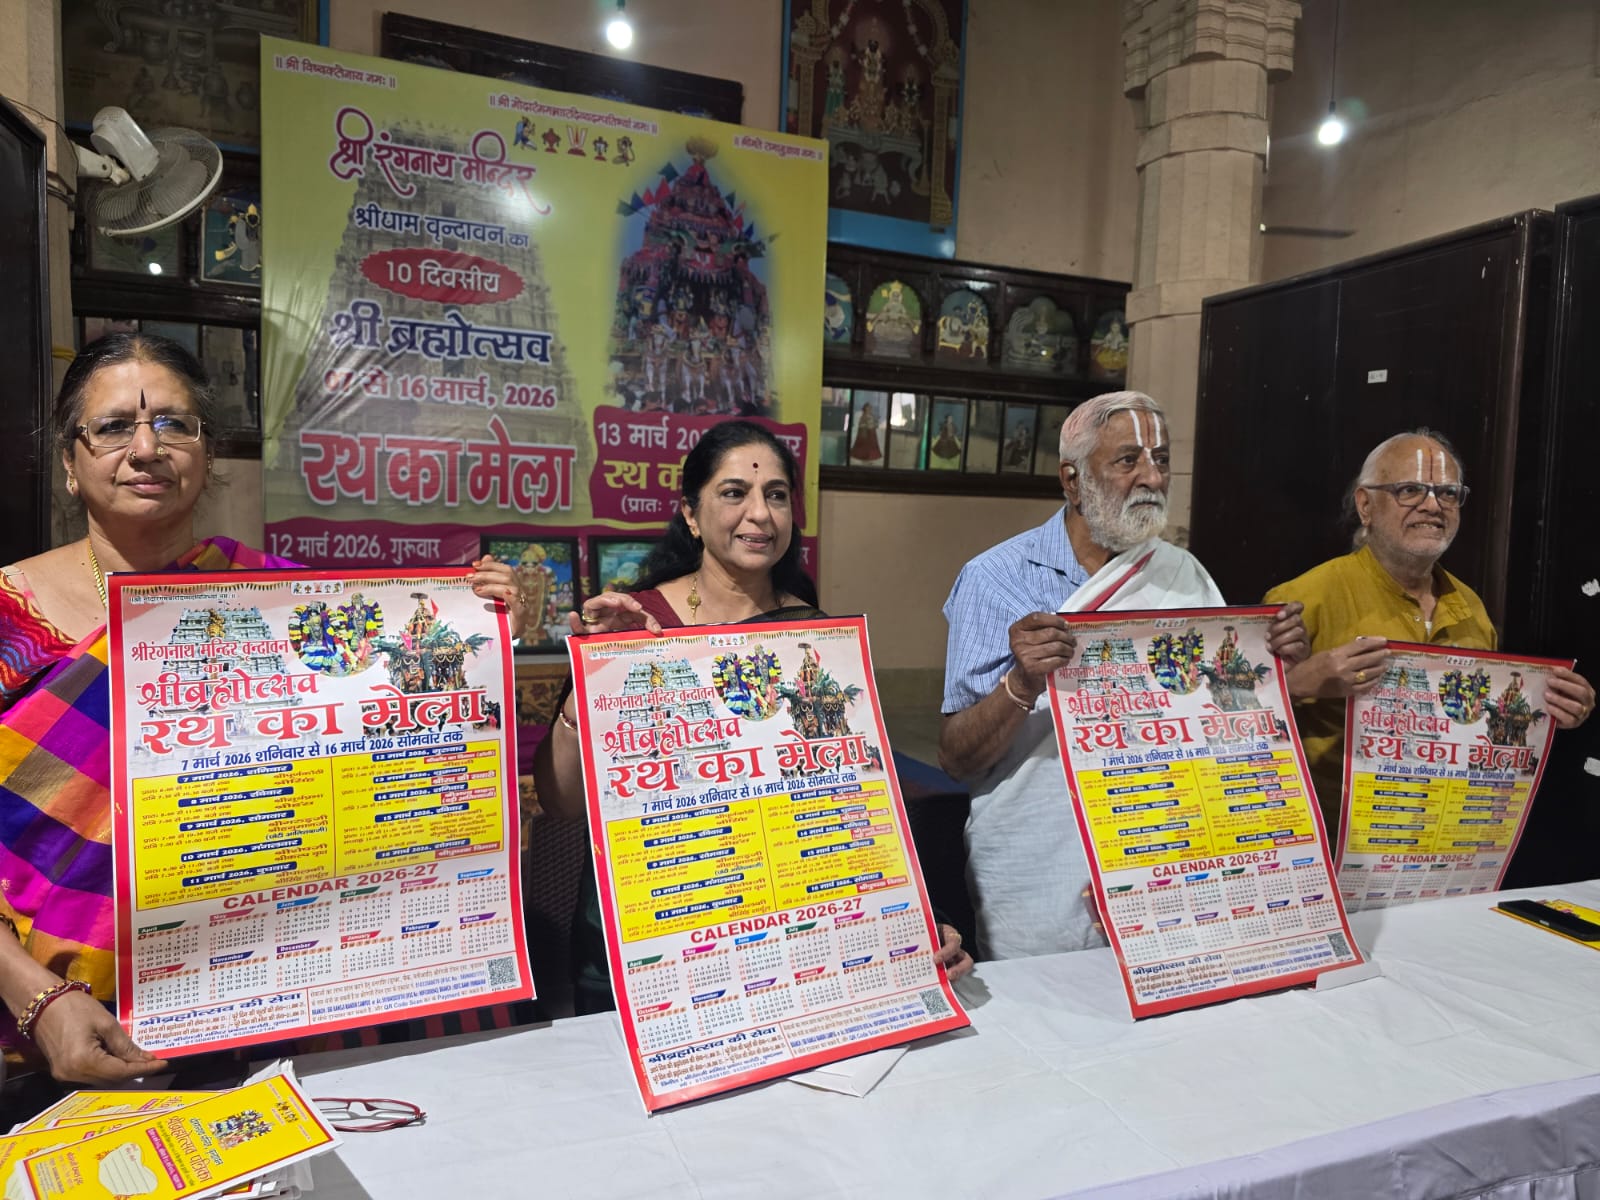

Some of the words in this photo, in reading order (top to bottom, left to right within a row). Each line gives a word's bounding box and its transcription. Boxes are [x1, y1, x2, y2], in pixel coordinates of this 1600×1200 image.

[286, 56, 299, 70] श्री
[330, 107, 374, 180] श्री
[373, 131, 456, 196] रंगनाथ
[460, 131, 551, 215] मन्दिर
[355, 203, 420, 233] श्रीधाम
[425, 216, 506, 243] वृन्दावन
[508, 232, 528, 248] का
[386, 261, 412, 284] 10
[420, 259, 501, 292] दिवसीय
[328, 300, 382, 348] श्री
[386, 310, 552, 362] ब्रह्मोत्सव
[362, 366, 389, 395] से
[400, 376, 426, 398] 16
[432, 375, 497, 407] मार्च,
[504, 385, 556, 408] 2026
[598, 422, 621, 446] 13
[628, 416, 670, 449] मार्च
[676, 427, 708, 450] 20
[301, 432, 382, 502] रथ
[385, 438, 463, 504] का
[467, 416, 576, 511] मेला
[603, 460, 650, 490] रथ
[658, 455, 685, 492] क
[621, 494, 662, 515] (प्रातः
[270, 533, 291, 558] 12
[298, 532, 330, 558] मार्च
[332, 536, 386, 561] 2026,
[132, 640, 195, 662] श्रीरंगनाथ
[200, 638, 238, 658] मन्दिर
[242, 639, 289, 662] वृन्दावन
[203, 663, 223, 674] का
[1098, 661, 1118, 676] मन्दिर
[137, 668, 320, 712] श्रीब्रह्मोत्सव
[594, 694, 643, 712] श्रीरंगनाथ
[646, 689, 676, 708] मन्दिर
[679, 686, 716, 707] वृन्दावन
[1067, 686, 1172, 720] श्रीब्रह्मोत्सव
[140, 714, 234, 754] रथ
[254, 702, 344, 740] का
[359, 684, 487, 730] मेला
[651, 710, 667, 720] का
[1072, 722, 1128, 752] रथ
[1136, 716, 1194, 746] का
[1198, 703, 1279, 739] मेला
[1360, 705, 1450, 735] श्रीब्रह्मोत्सव
[601, 714, 742, 757] श्रीब्रह्मोत्सव
[182, 760, 188, 772] 7
[193, 752, 220, 769] मार्च
[224, 752, 251, 766] 2026
[256, 744, 305, 762] शनिवार
[308, 740, 320, 756] से
[325, 744, 337, 755] 16
[340, 736, 366, 753] मार्च
[369, 737, 394, 750] 2026
[396, 731, 441, 748] सोमवार
[443, 730, 464, 744] तक
[607, 758, 680, 798] रथ
[694, 746, 766, 783] का
[774, 729, 871, 772] मेला
[1109, 754, 1126, 766] मार्च
[1127, 754, 1144, 764] 2026
[1144, 748, 1174, 763] शनिवार
[1176, 748, 1184, 759] से
[1186, 748, 1194, 758] 16
[1194, 744, 1211, 756] मार्च
[1360, 734, 1406, 761] रथ
[1416, 740, 1462, 765] का
[1468, 734, 1536, 769] मेला
[192, 772, 215, 782] मार्च
[246, 764, 288, 776] शनिवार
[200, 794, 220, 804] मार्च
[250, 788, 284, 799] रविवार
[642, 803, 648, 814] 7
[651, 796, 673, 812] मार्च
[676, 796, 697, 809] 2026
[698, 787, 737, 804] शनिवार
[740, 783, 750, 799] से
[752, 784, 763, 796] 16
[764, 778, 785, 794] मार्च
[786, 779, 806, 790] 2026
[808, 773, 840, 788] सोमवार
[842, 771, 857, 783] तक
[196, 818, 217, 828] मार्च
[248, 811, 287, 823] सोमवार
[196, 850, 220, 860] मार्च
[250, 839, 299, 853] मंगलवार
[1152, 858, 1226, 878] CALENDAR
[1230, 850, 1279, 870] 2026-27
[1381, 853, 1438, 864] CALENDAR
[1440, 852, 1477, 864] 2026-27
[204, 874, 225, 884] मार्च
[223, 878, 349, 910] CALENDAR
[356, 864, 439, 887] 2026-27
[690, 912, 791, 944] CALENDAR
[796, 898, 862, 923] 2026-27
[212, 954, 244, 964] November
[280, 942, 312, 952] December
[141, 968, 168, 976] October
[138, 1004, 234, 1028] श्रीब्रह्मोत्सव
[240, 998, 263, 1010] की
[268, 992, 302, 1004] सेवा
[437, 992, 461, 1002] Payment
[648, 1038, 725, 1064] श्रीब्रह्मोत्सव
[728, 1034, 748, 1044] की
[750, 1026, 777, 1039] सेवा
[189, 1154, 213, 1183] पत्रिका
